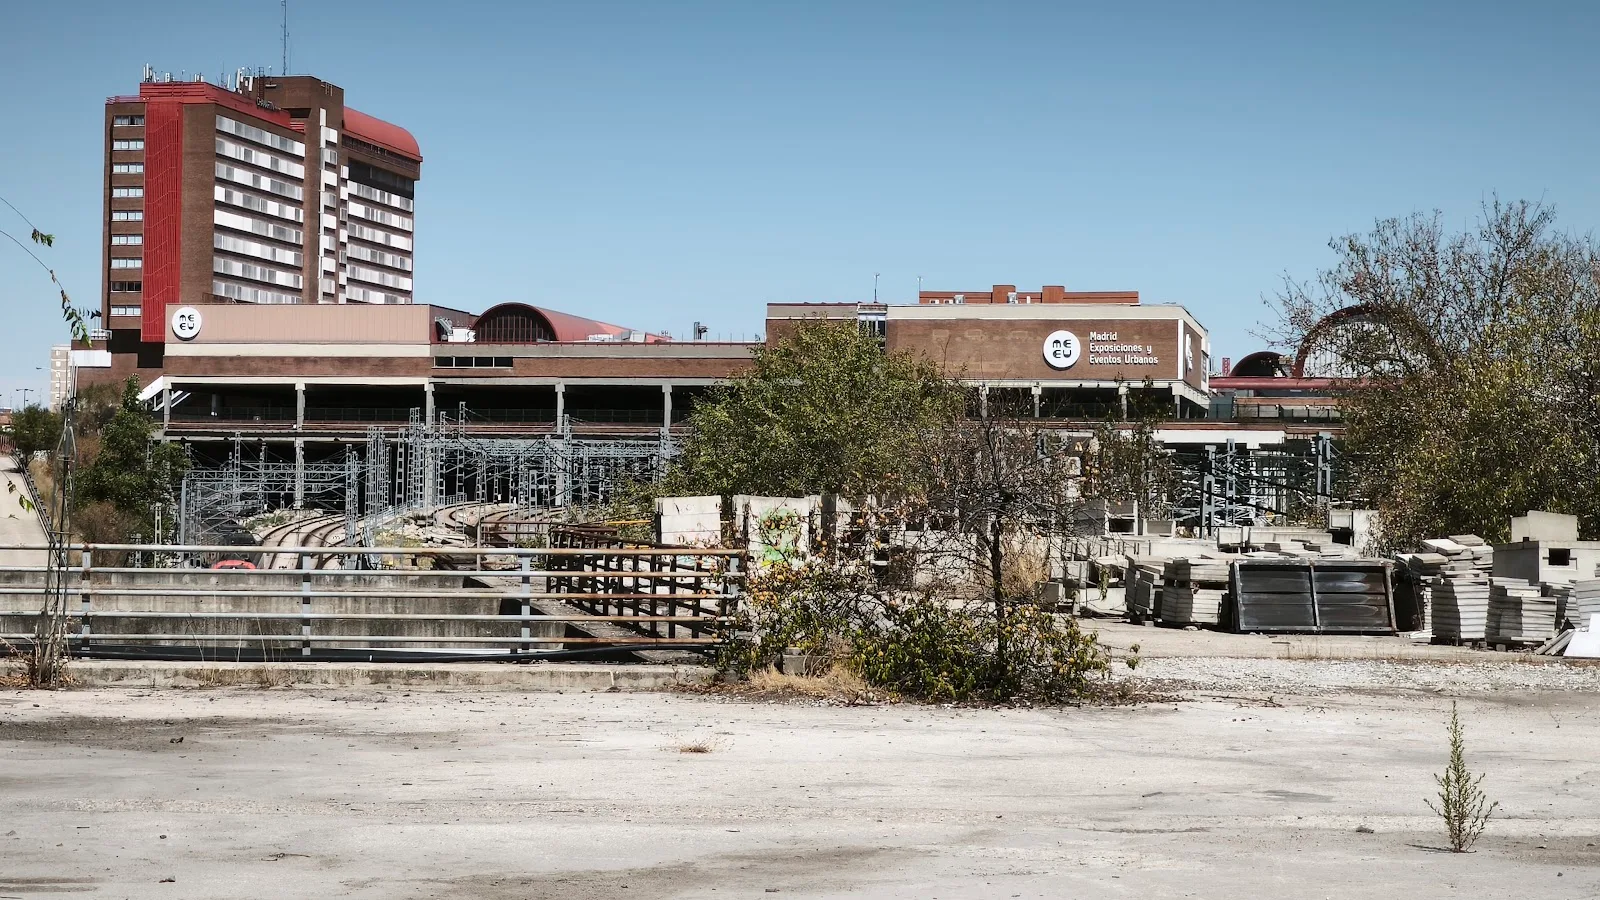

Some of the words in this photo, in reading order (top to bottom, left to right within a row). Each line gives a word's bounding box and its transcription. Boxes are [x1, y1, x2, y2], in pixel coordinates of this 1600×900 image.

[1090, 332, 1118, 340] Madrid
[1090, 343, 1142, 354] Exposiciones
[1146, 345, 1152, 354] y
[1090, 354, 1122, 363] Eventos
[1124, 354, 1159, 363] Urbanos
